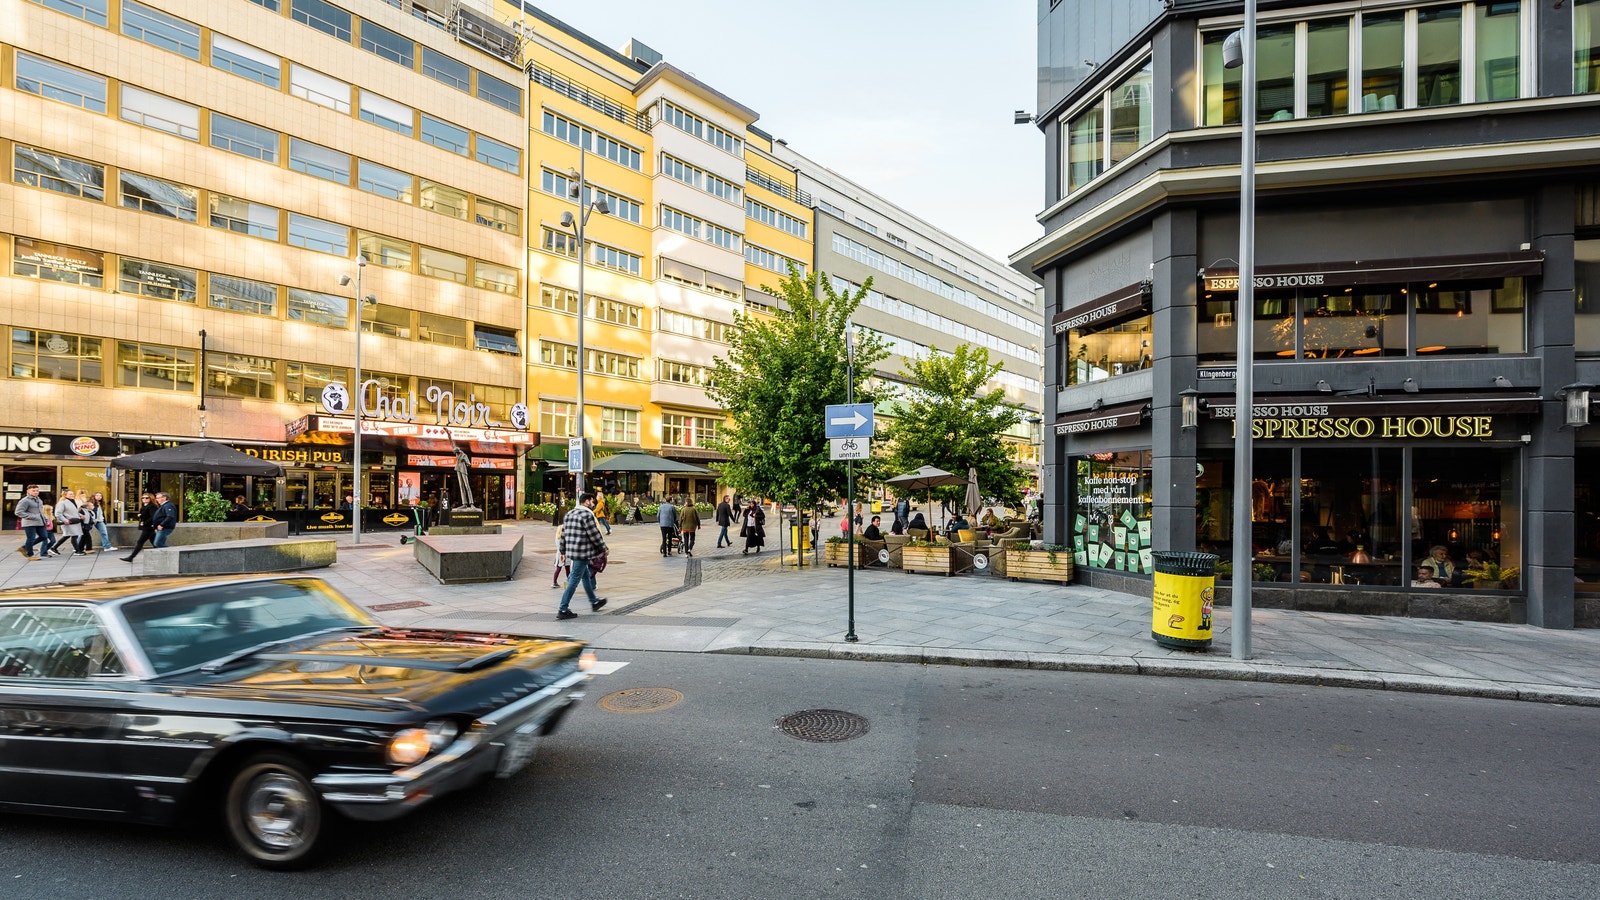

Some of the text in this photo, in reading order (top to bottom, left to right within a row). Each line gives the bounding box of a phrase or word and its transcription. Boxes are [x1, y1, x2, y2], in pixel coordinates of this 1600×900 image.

[1210, 274, 1324, 289] ESPRSSO HOUSE
[1055, 304, 1117, 334] ESPRESSO HOUSE
[360, 379, 502, 427] Chat Noir
[1214, 405, 1329, 418] ESPSSO HOUSE
[1056, 418, 1118, 434] ESPRESSO HOUSE
[1231, 416, 1493, 438] SPRESSO HOUSE
[262, 449, 308, 461] IRISH
[313, 451, 343, 462] PUB
[1084, 476, 1137, 486] Kaffe non-stop
[1093, 485, 1127, 494] med vårt
[1077, 495, 1144, 505] kaffeabonnement!
